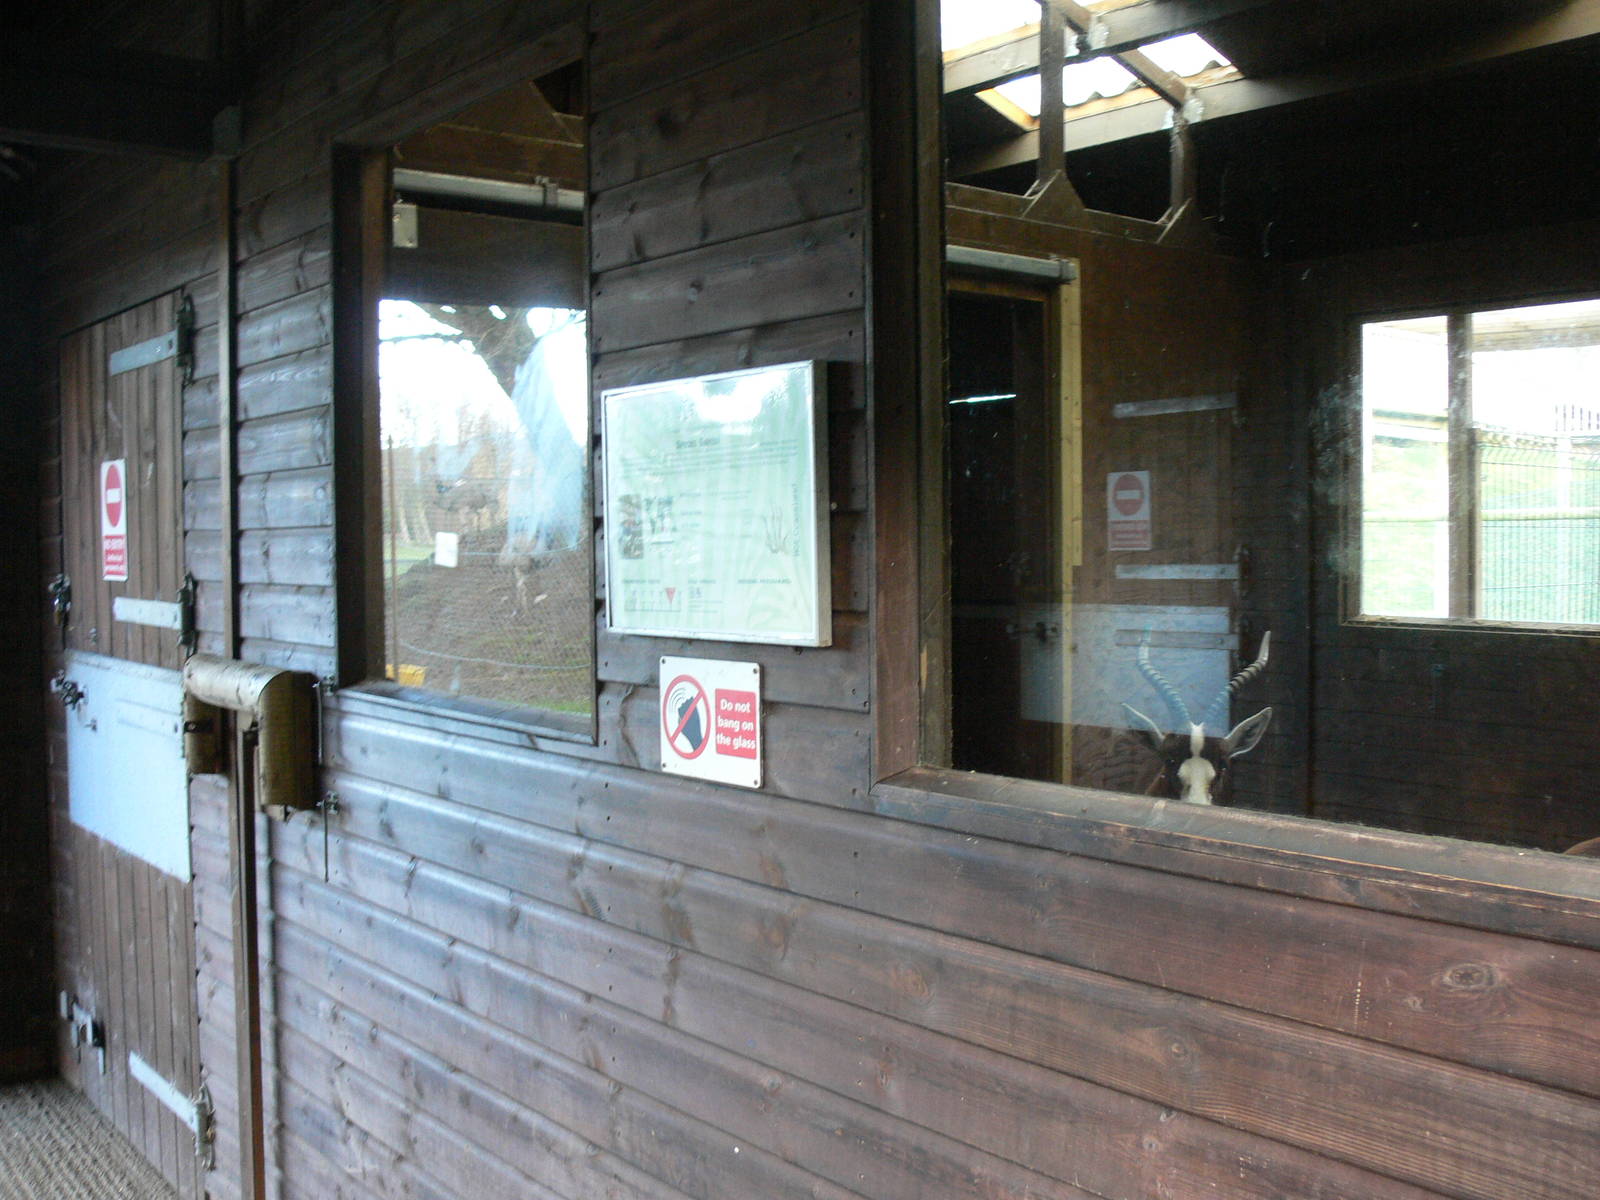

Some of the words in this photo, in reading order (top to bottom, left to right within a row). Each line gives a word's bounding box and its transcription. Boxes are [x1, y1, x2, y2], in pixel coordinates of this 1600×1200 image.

[720, 698, 733, 711] Do
[735, 702, 751, 713] not
[717, 714, 740, 732] bang
[741, 721, 754, 731] on
[716, 733, 731, 746] the
[732, 735, 756, 750] glass
